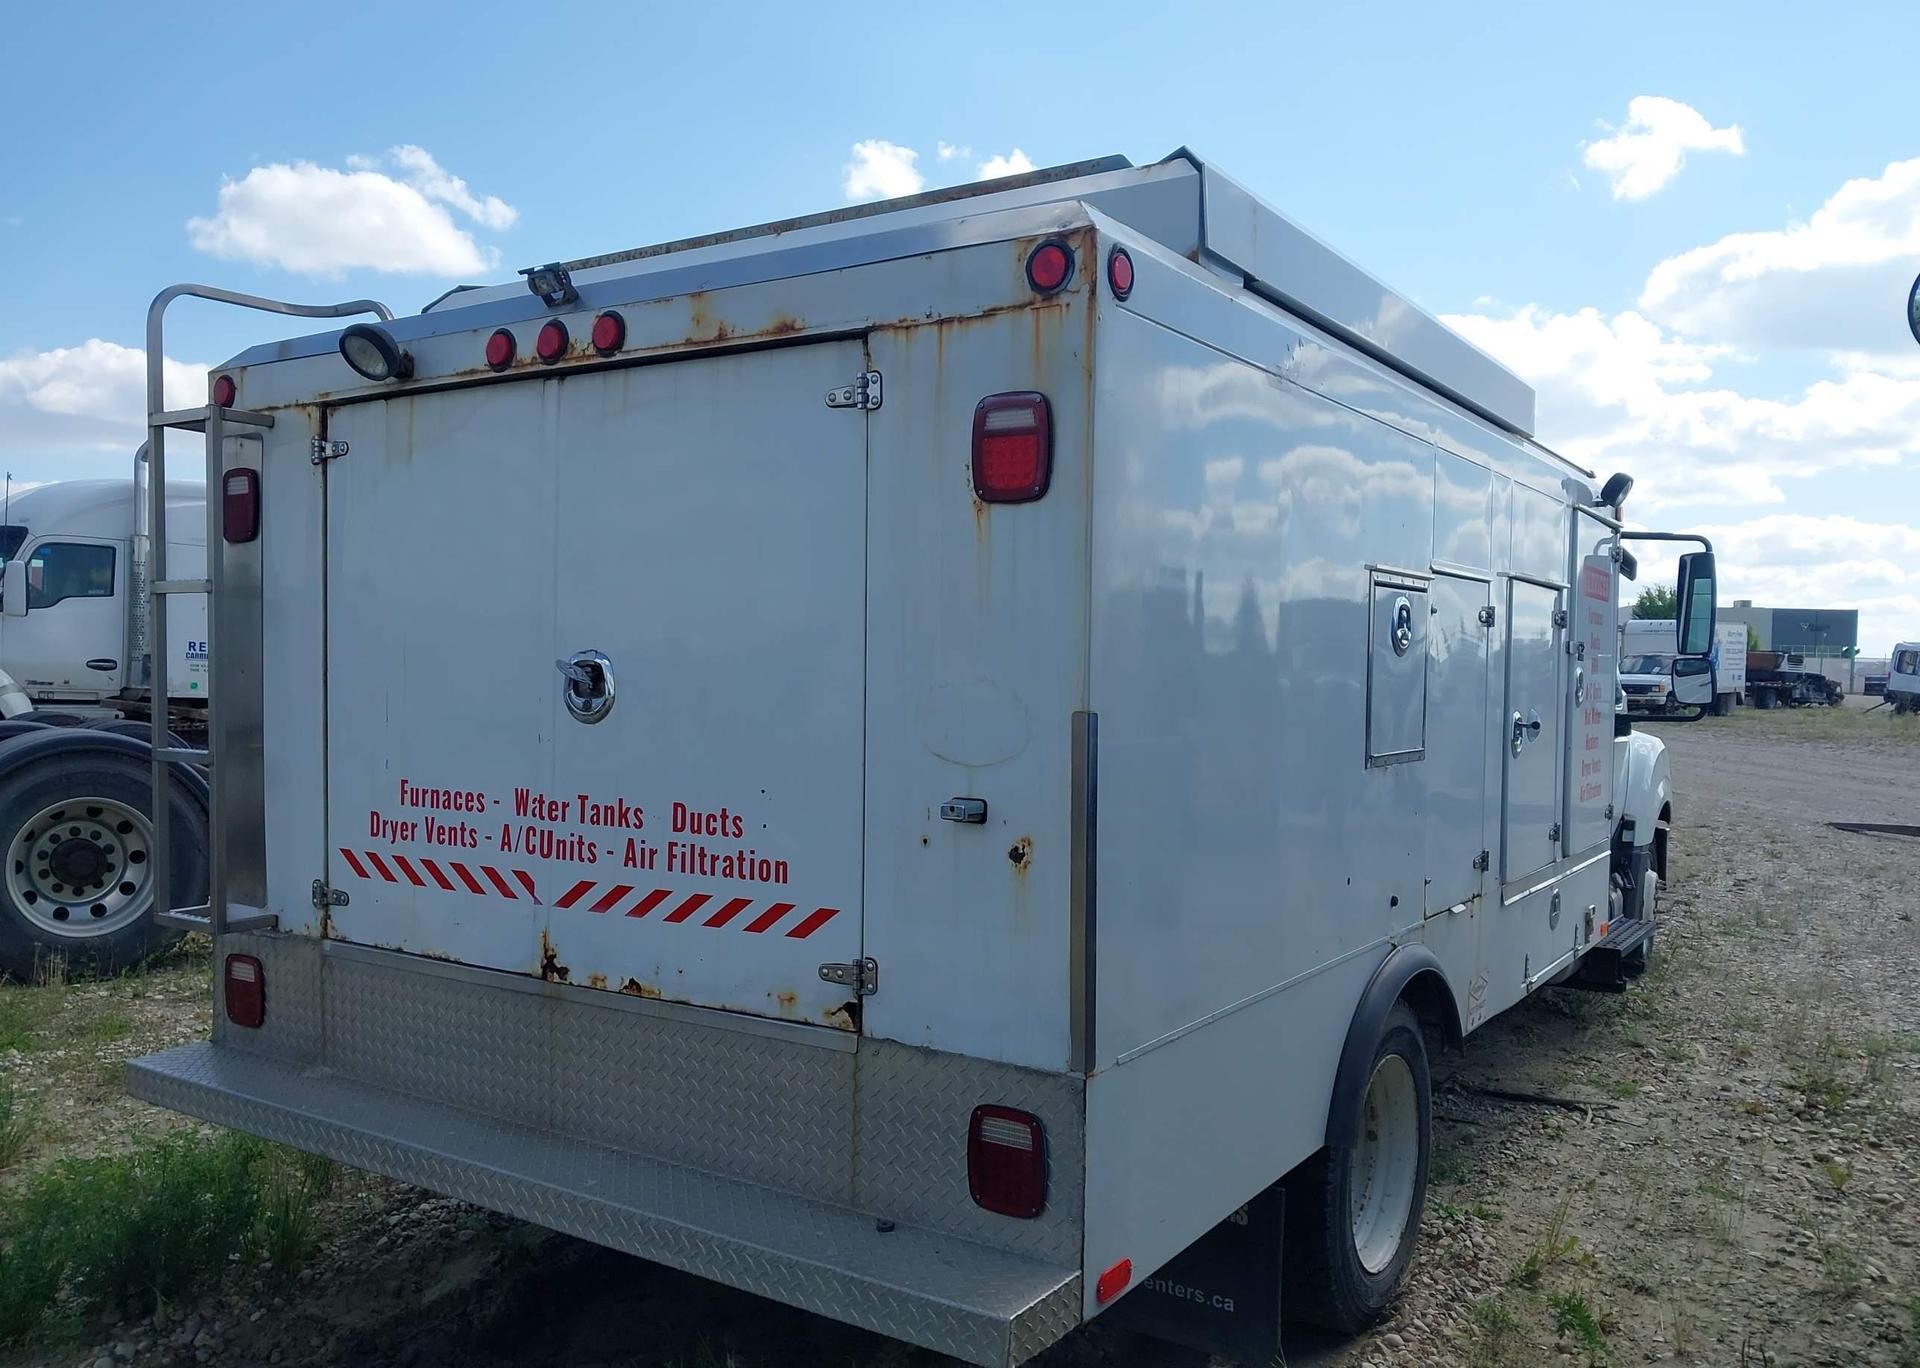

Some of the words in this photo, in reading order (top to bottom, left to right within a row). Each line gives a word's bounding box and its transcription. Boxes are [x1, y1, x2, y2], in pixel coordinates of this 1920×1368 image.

[399, 779, 486, 813] Furnaces
[514, 788, 570, 823] Water
[577, 794, 644, 830] Tanks
[672, 802, 744, 839] Ducts
[370, 811, 417, 844] Dryer
[425, 816, 478, 849] Vents
[623, 837, 658, 870] Air
[667, 841, 790, 885] Filtration
